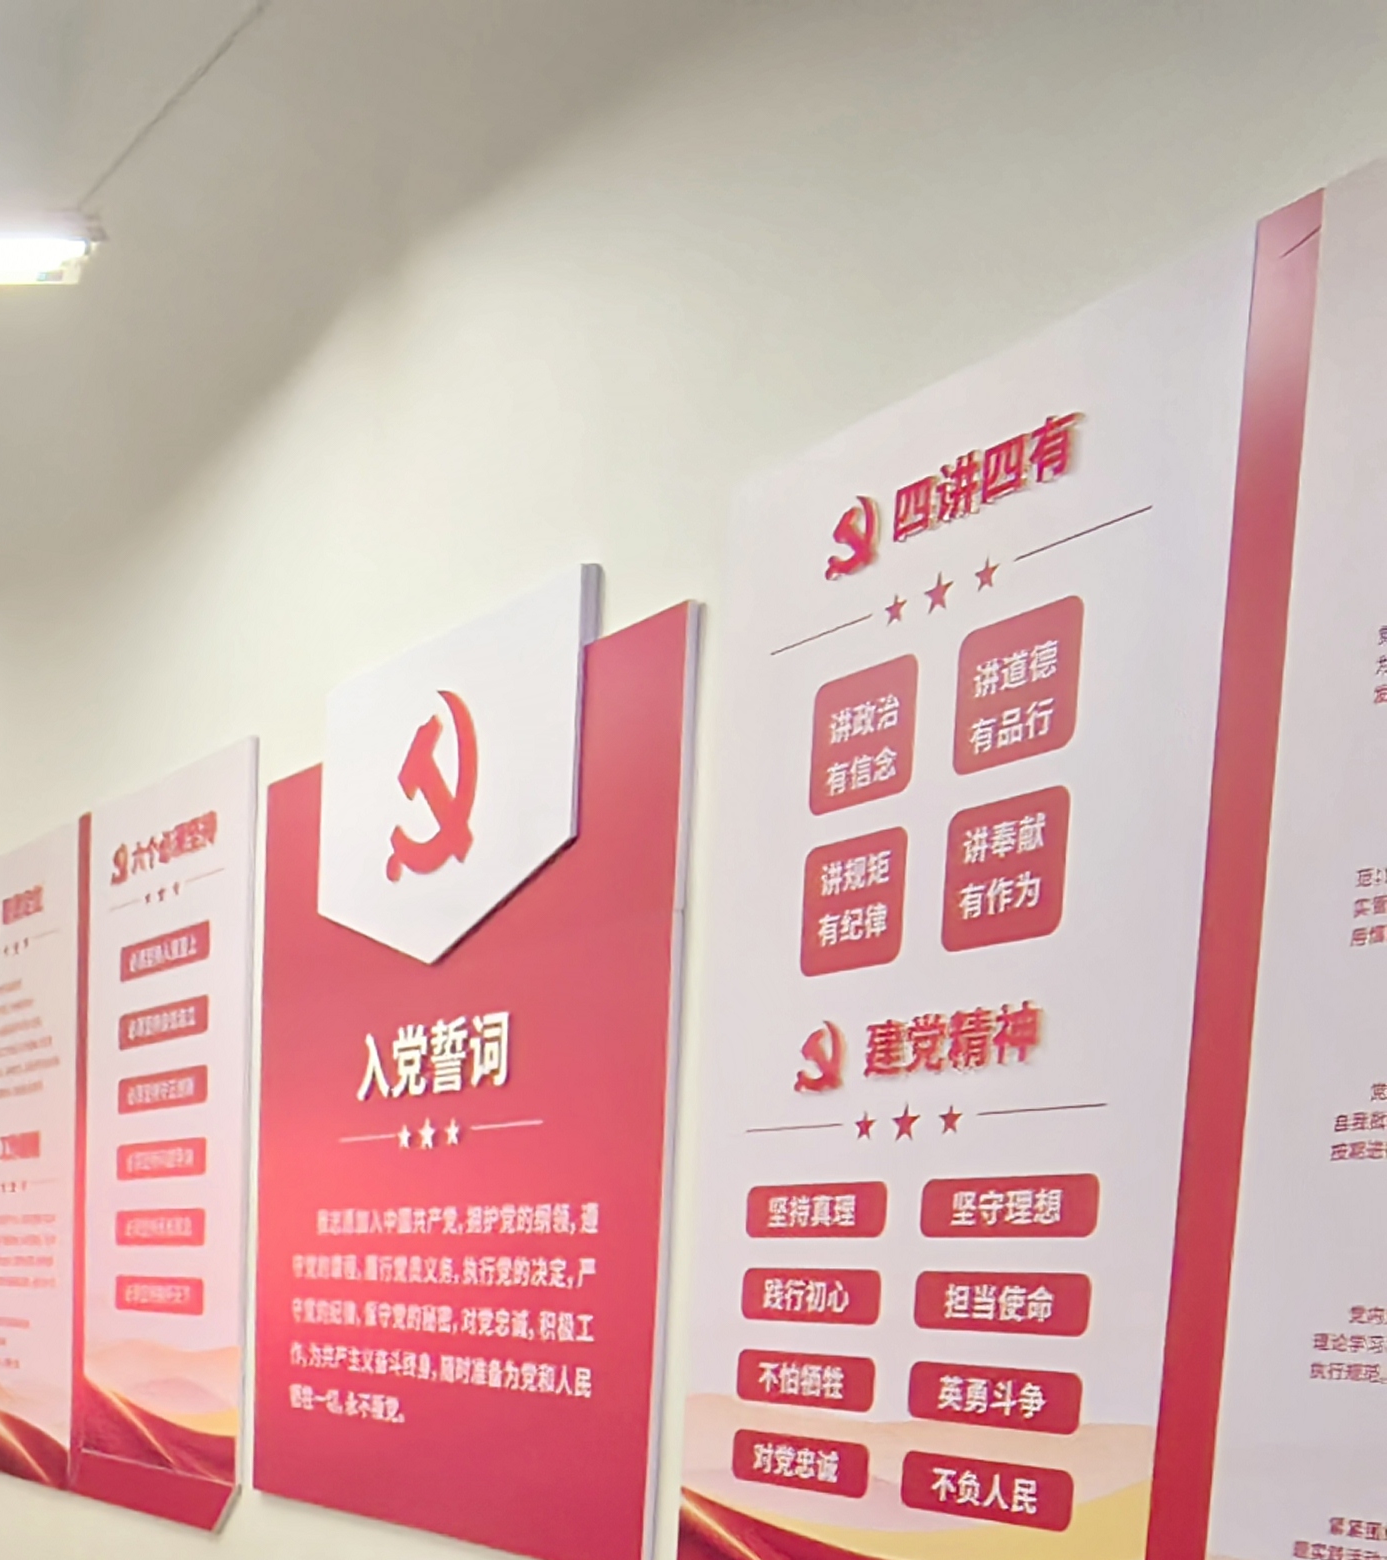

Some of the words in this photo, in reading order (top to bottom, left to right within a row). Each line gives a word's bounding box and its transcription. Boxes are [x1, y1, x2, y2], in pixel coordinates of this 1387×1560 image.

[893, 412, 1080, 541] 四讲四有
[975, 641, 1058, 697] 讲道德
[830, 693, 900, 745] 讲政治
[971, 699, 1055, 755] 有品行
[826, 747, 897, 796] 有信念
[963, 813, 1046, 864] 讲奉献
[821, 851, 891, 896] 讲规矩
[959, 872, 1041, 920] 有作为
[817, 903, 887, 947] 有纪律
[356, 1011, 509, 1102] 入党誓词
[864, 1002, 1041, 1078] 建党精神
[767, 1194, 857, 1228] 坚持真理
[950, 1188, 1063, 1227] 坚守理想
[762, 1278, 850, 1313] 践行初心
[943, 1283, 1054, 1323] 担当使命
[757, 1361, 845, 1401] 不怕牺牲
[937, 1374, 1048, 1418] 英勇斗争
[752, 1443, 840, 1485] 对党忠诚
[930, 1467, 1039, 1516] 不负人民
